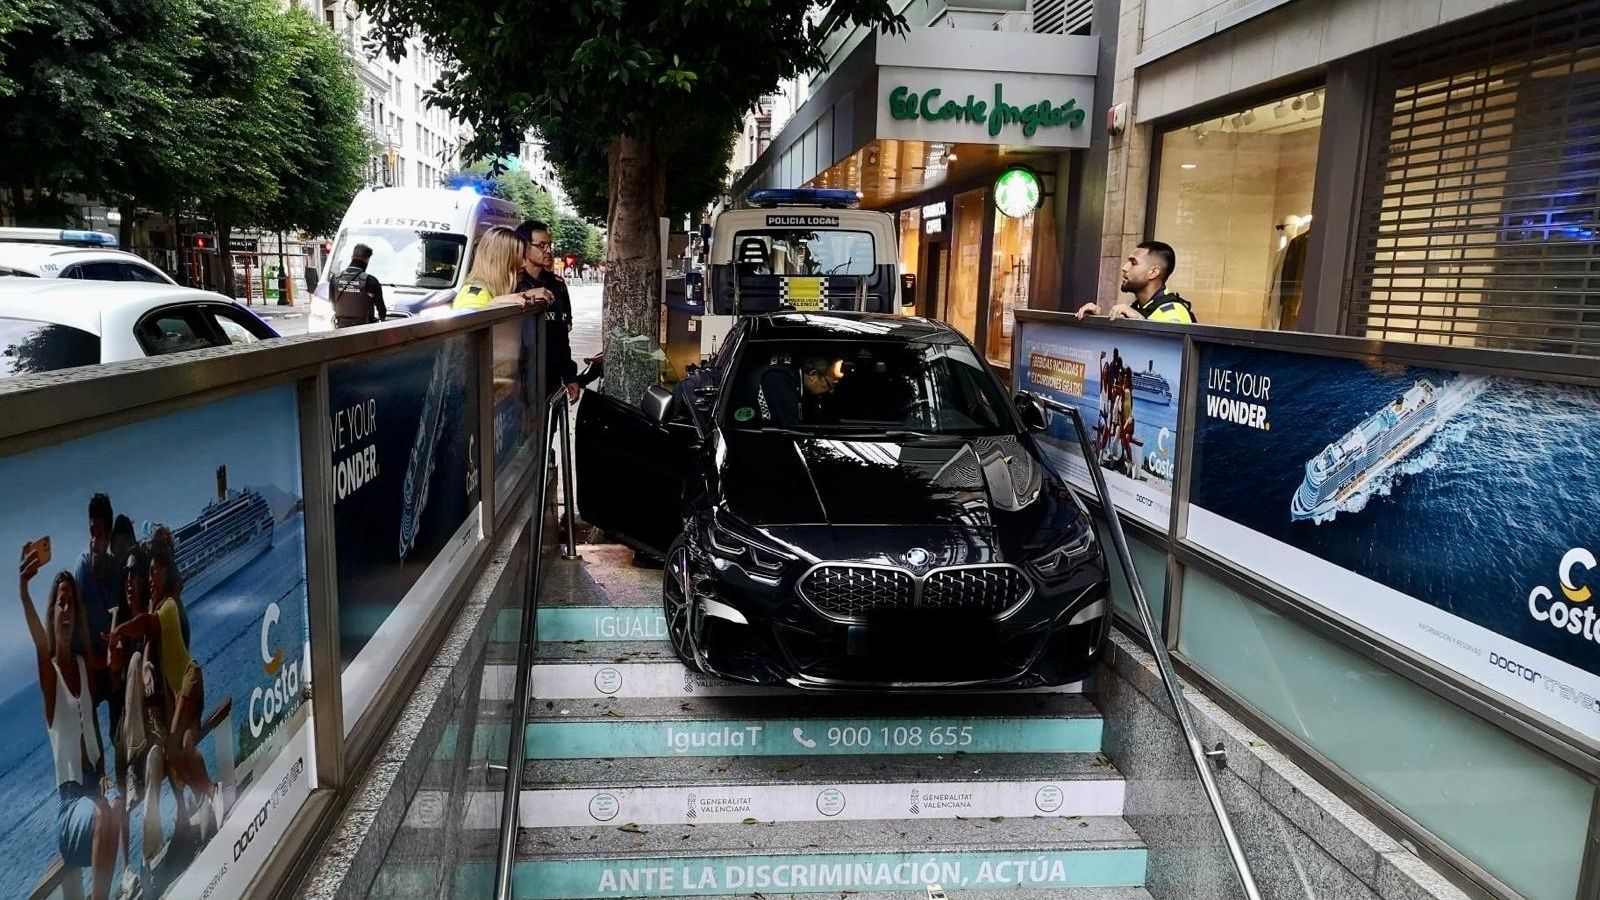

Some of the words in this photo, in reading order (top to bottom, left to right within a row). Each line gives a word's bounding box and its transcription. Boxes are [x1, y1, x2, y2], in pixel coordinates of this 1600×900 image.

[889, 86, 919, 120] El
[919, 88, 987, 123] Corte
[362, 217, 451, 231] ATESTATS
[768, 217, 805, 225] POLICIA
[807, 217, 838, 226] LOCAL
[1208, 367, 1232, 392] LIVE
[1235, 371, 1271, 401] YOUR
[346, 398, 377, 444] YOUR
[1206, 394, 1270, 431] WONDER.
[249, 658, 299, 738] Costa
[827, 726, 872, 748] 900
[881, 726, 923, 747] 108
[929, 726, 974, 746] 655
[700, 798, 752, 806] GENERALITAT
[701, 805, 750, 813] VALENCIANA
[598, 868, 674, 892] ANTE
[682, 866, 718, 889] LA
[725, 857, 969, 889] DISCRIMINACIÓN,
[975, 856, 1068, 884] ACTÚA
